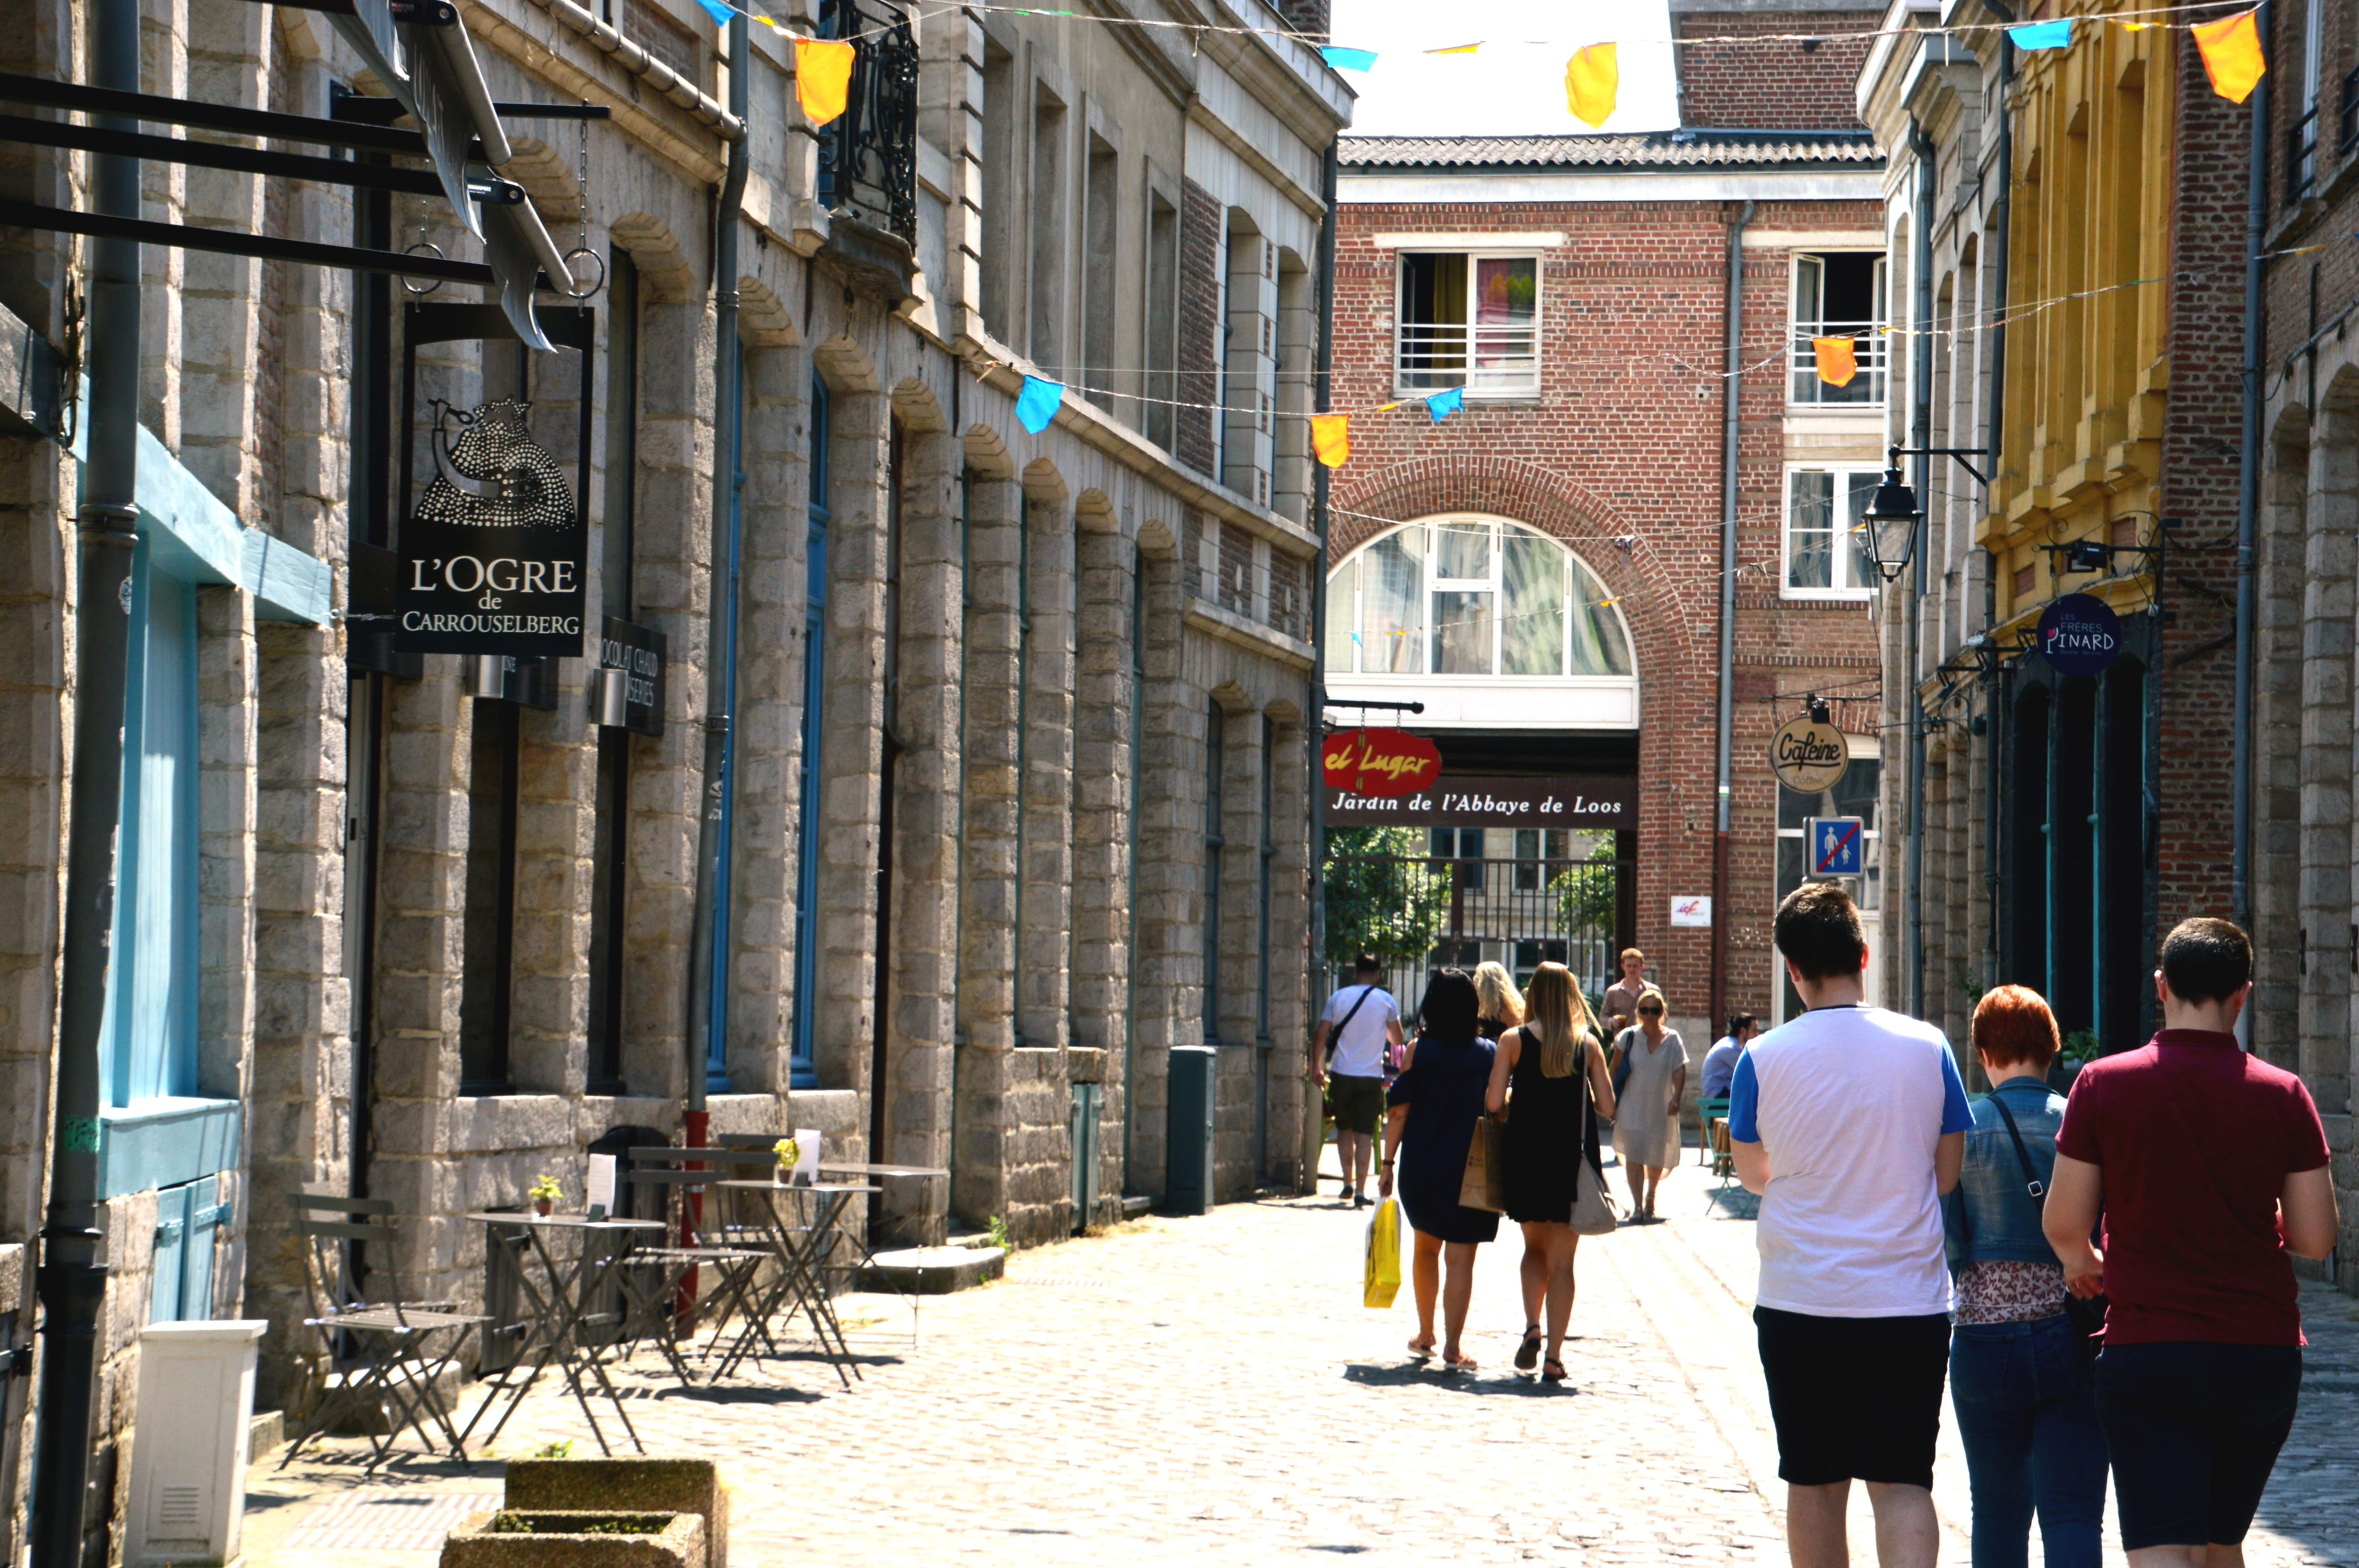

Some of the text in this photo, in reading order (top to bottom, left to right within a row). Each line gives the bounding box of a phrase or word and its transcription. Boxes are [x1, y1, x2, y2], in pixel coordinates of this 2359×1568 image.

[411, 555, 577, 594] L'OGRE
[478, 589, 502, 610] de
[402, 610, 579, 635] CARROUSELBERG
[2061, 621, 2103, 633] FRÈRES
[601, 638, 633, 670] OCOLAT
[1325, 745, 1430, 780] el Lugar
[1332, 793, 1621, 816] Jardin de l'Abbaye de Loos
